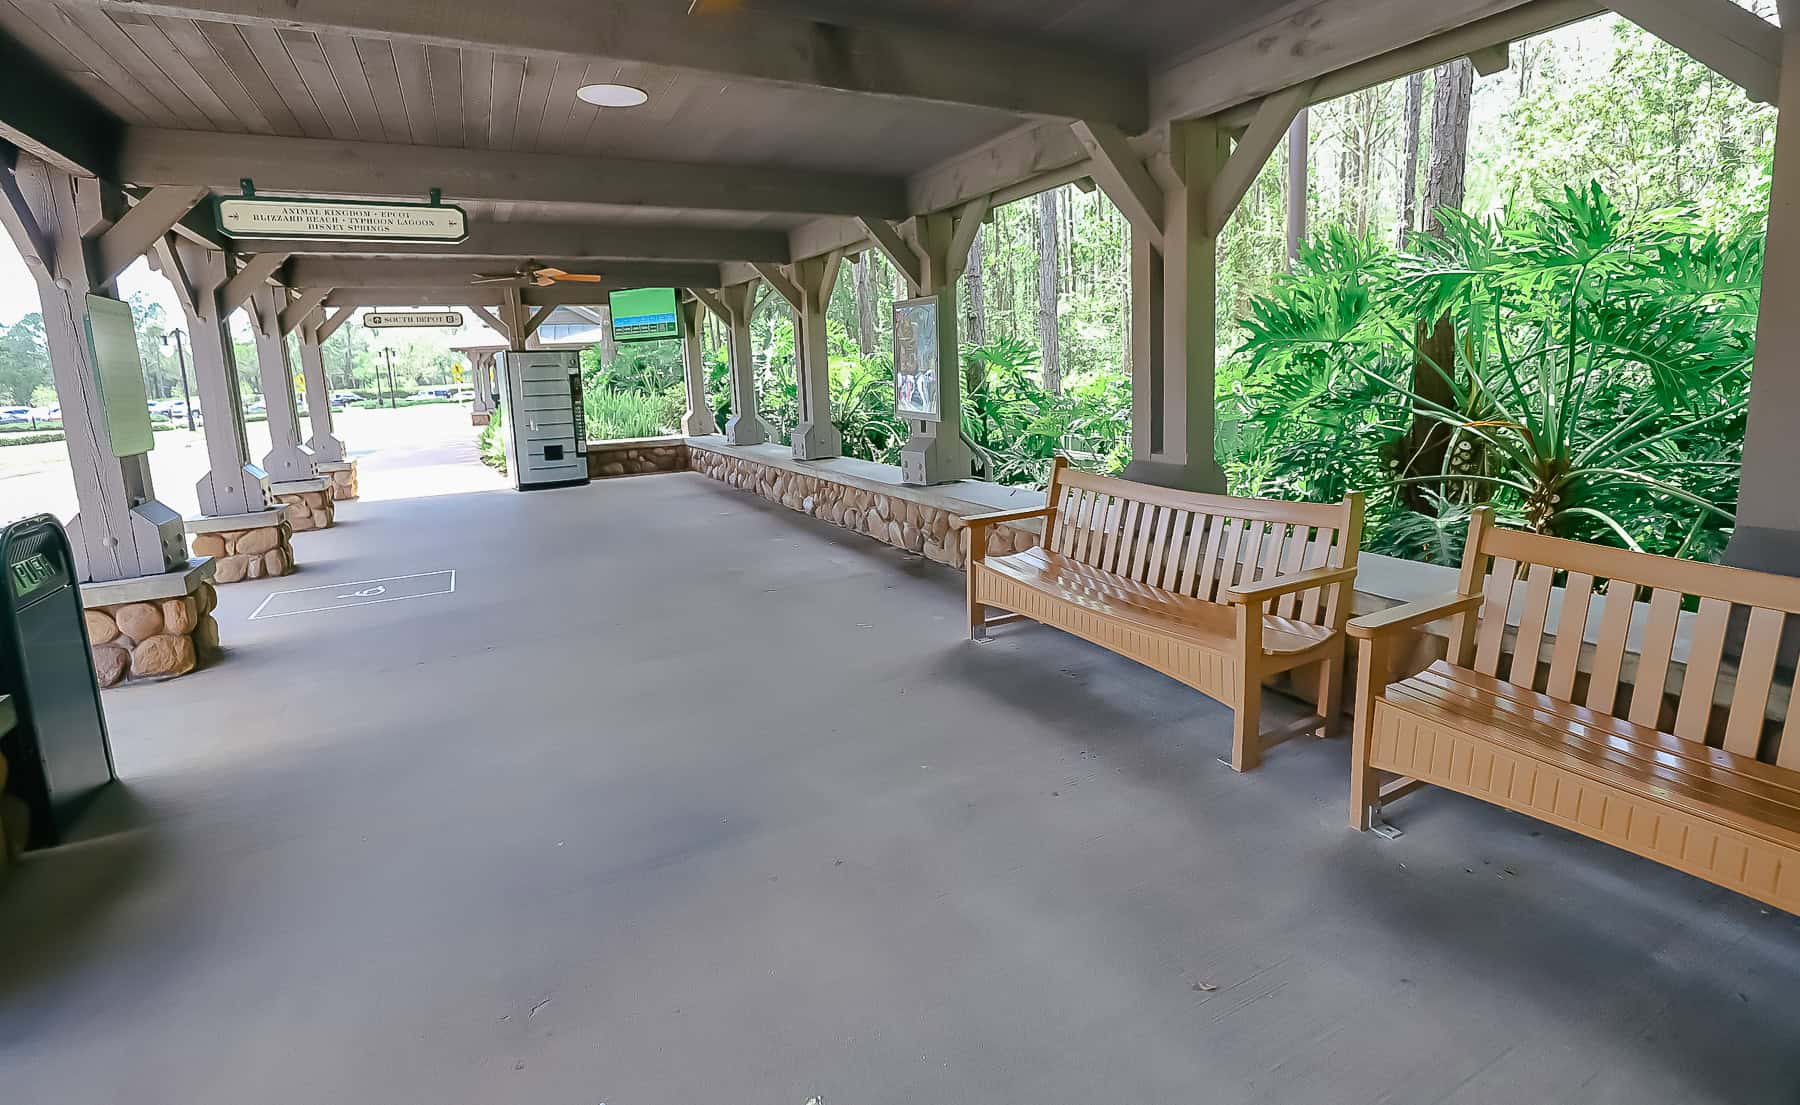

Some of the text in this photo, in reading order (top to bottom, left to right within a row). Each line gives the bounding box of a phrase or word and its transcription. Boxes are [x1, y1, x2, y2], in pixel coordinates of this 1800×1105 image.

[281, 207, 410, 219] ANIMAL KINGDOM EPCOT
[252, 214, 303, 222] BLIZZARD
[349, 217, 393, 225] TYPHOON
[308, 223, 344, 231] DISNEY
[416, 315, 442, 323] DEPOT
